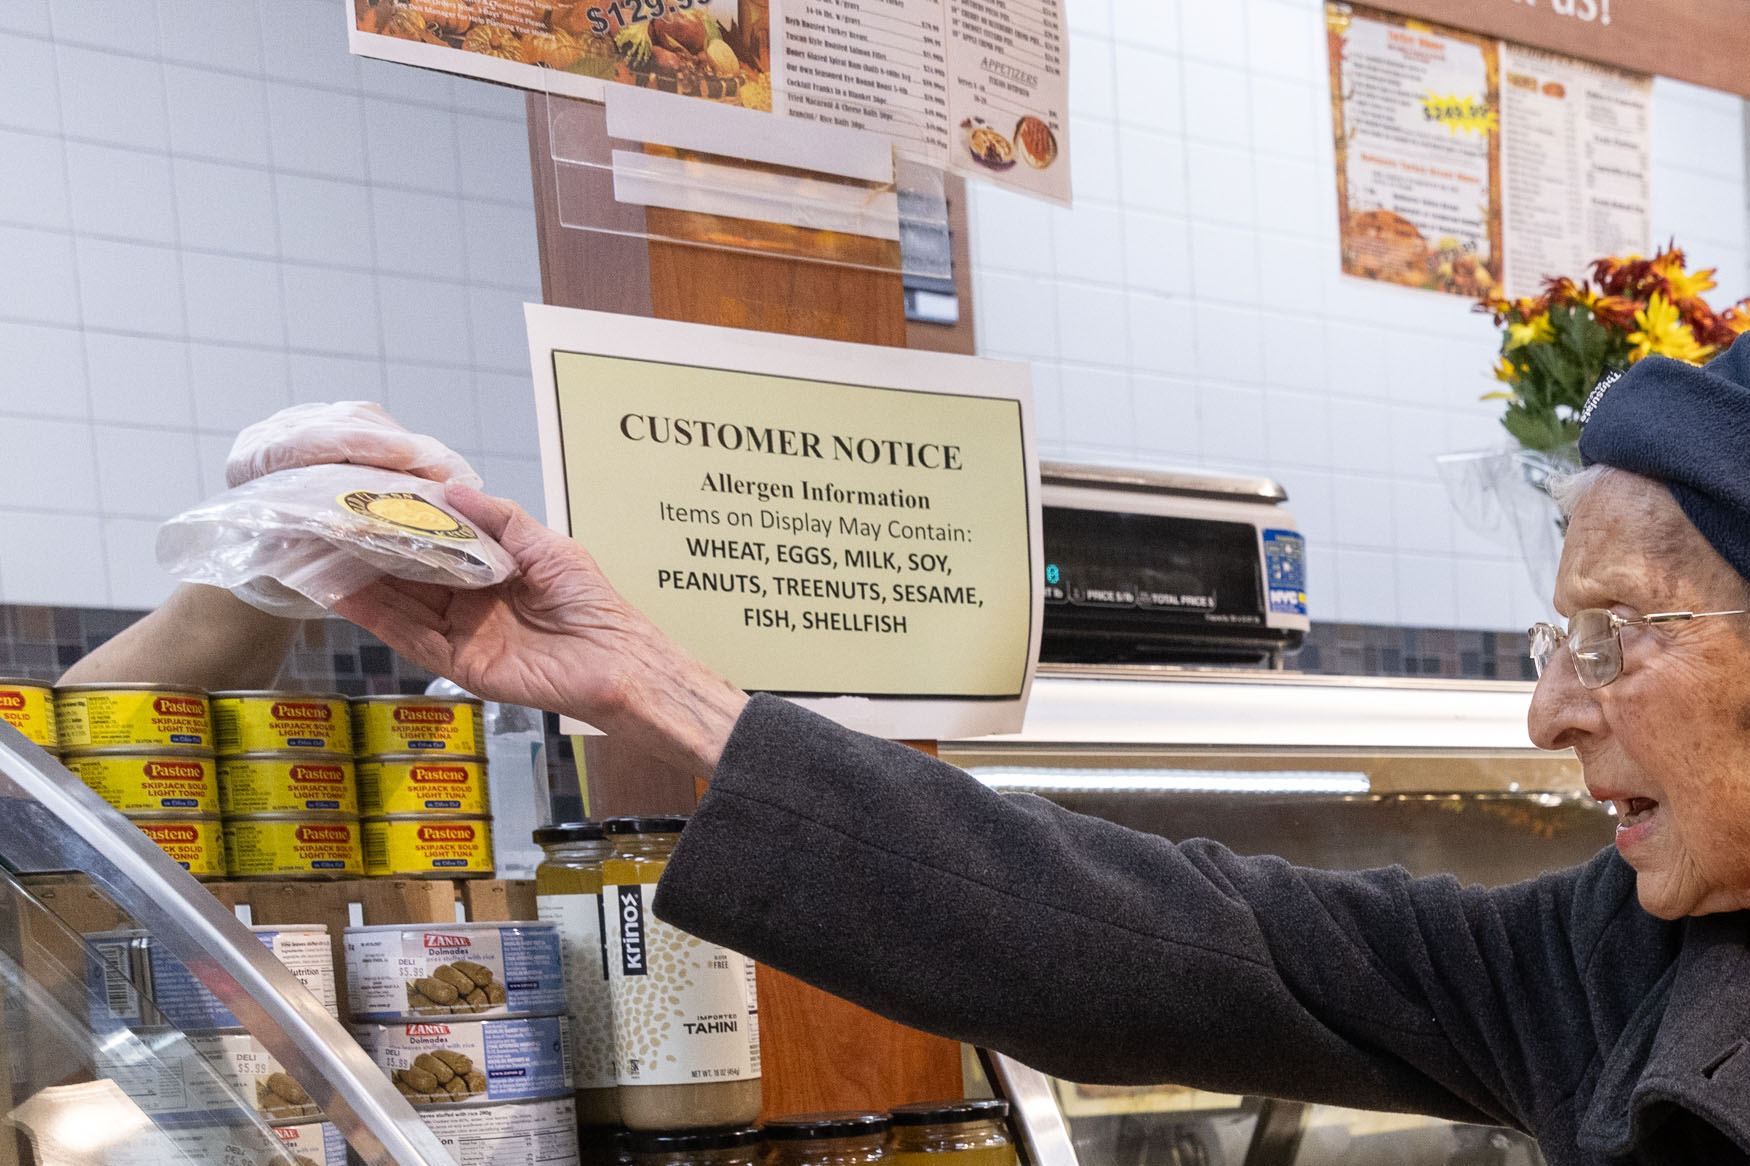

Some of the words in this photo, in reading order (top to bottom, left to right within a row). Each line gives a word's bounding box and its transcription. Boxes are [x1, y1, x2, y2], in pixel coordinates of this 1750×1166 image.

[620, 413, 824, 459] CUSTOMER
[833, 435, 963, 470] NOTICE
[701, 472, 794, 502] Allergen
[801, 481, 930, 509] Information
[660, 502, 720, 525] Items
[727, 511, 753, 527] on
[761, 510, 832, 535] Display
[840, 517, 881, 541] May
[889, 520, 972, 542] Contain:
[686, 537, 770, 564] WHEAT,
[777, 544, 838, 570] EGGS,
[845, 548, 902, 574] MILK,
[908, 554, 952, 575] SOY,
[658, 569, 767, 597] PEANUTS,
[773, 577, 886, 604] TREENUTS,
[893, 584, 984, 608] SESAME,
[1087, 590, 1115, 602] PRICE
[1178, 594, 1207, 607] PRICE
[744, 608, 796, 632] FISH,
[803, 611, 907, 633] SHELLFISH
[278, 706, 328, 718] Pastene
[400, 709, 450, 721] Pastene
[151, 763, 201, 778] Pastene
[297, 768, 342, 780] Pastene
[416, 769, 465, 781] Pastene
[302, 828, 348, 840] Pastene
[424, 828, 472, 839] Pastene
[429, 948, 469, 956] Dolmades
[398, 958, 416, 966] DELI
[714, 961, 728, 969] FREE
[683, 1023, 738, 1035] TAHINI
[691, 1070, 701, 1078] NET
